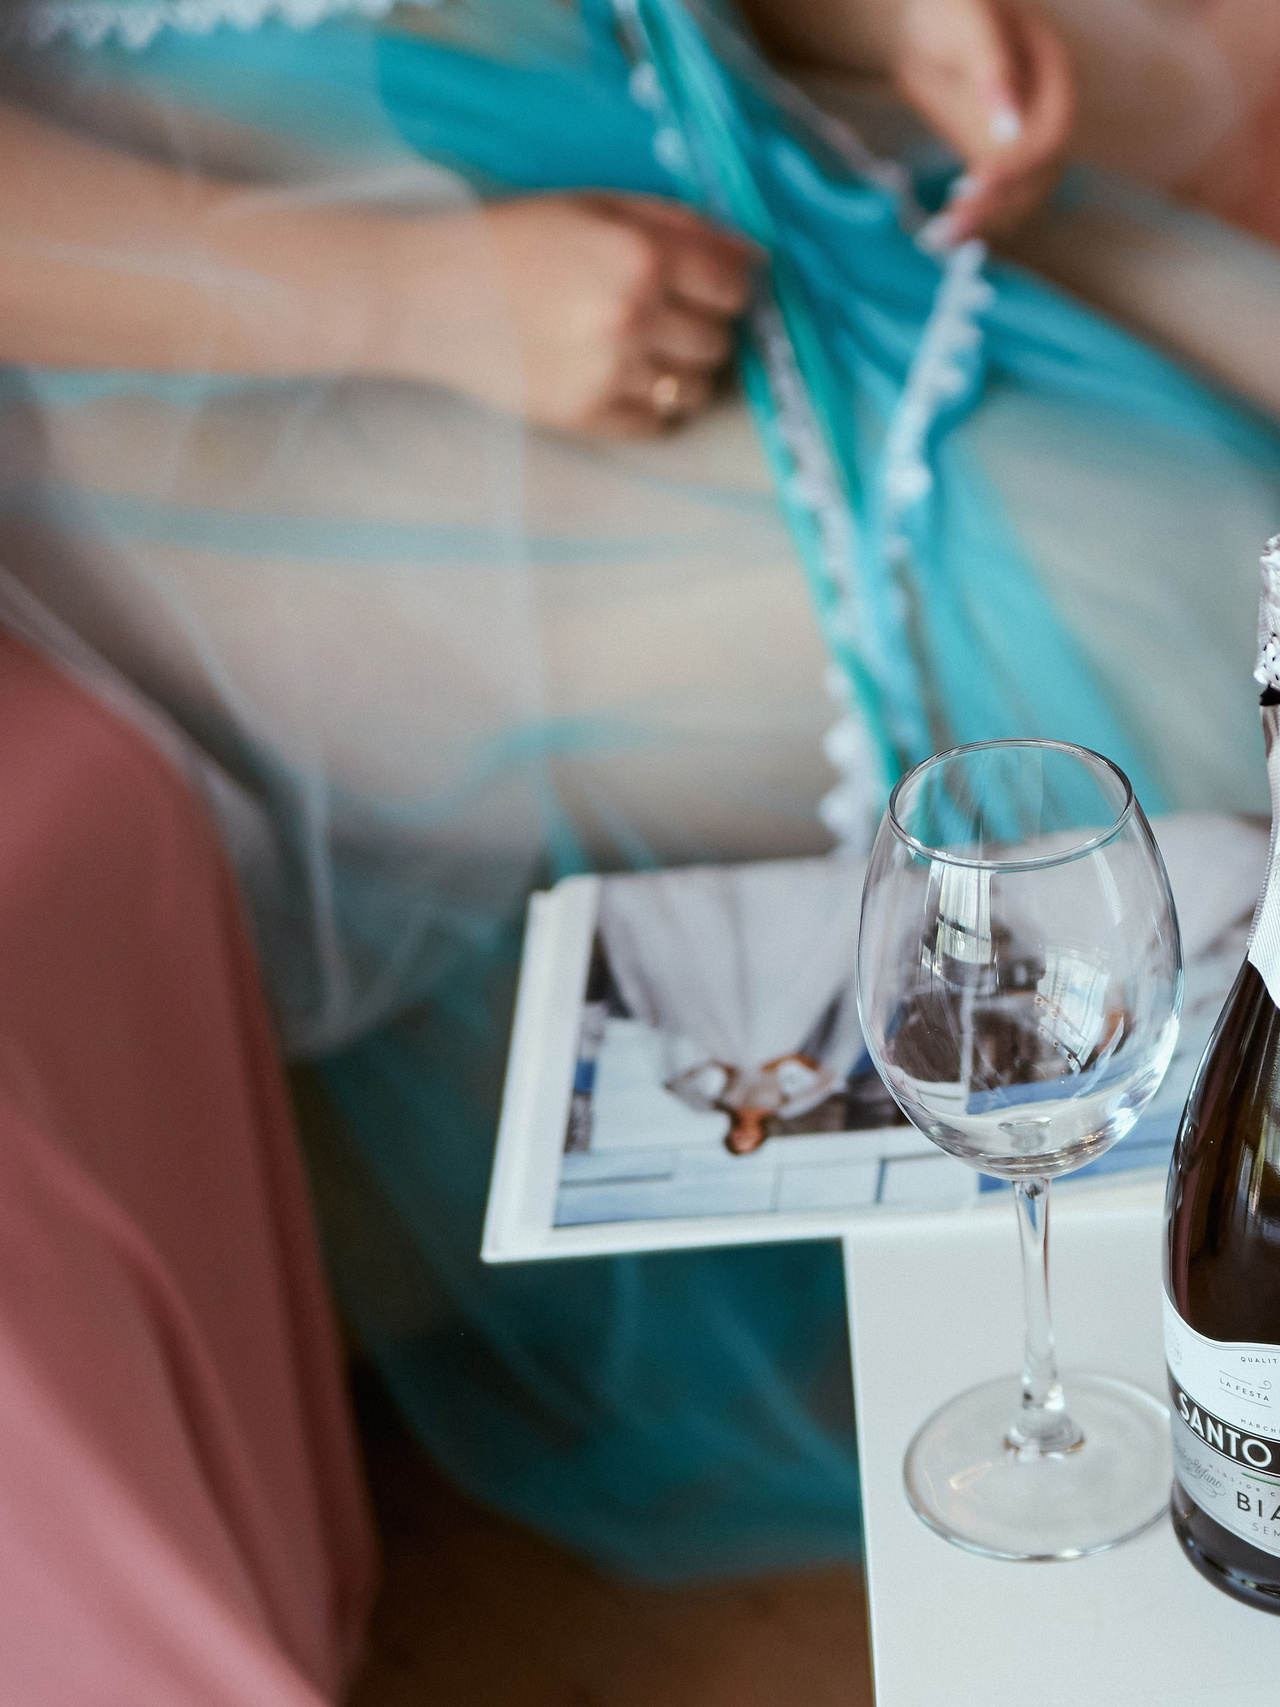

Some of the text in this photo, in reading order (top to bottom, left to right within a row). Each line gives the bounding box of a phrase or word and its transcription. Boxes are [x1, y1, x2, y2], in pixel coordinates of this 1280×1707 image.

[1219, 1377, 1270, 1402] LA FESTA
[1177, 1391, 1273, 1468] SANTO
